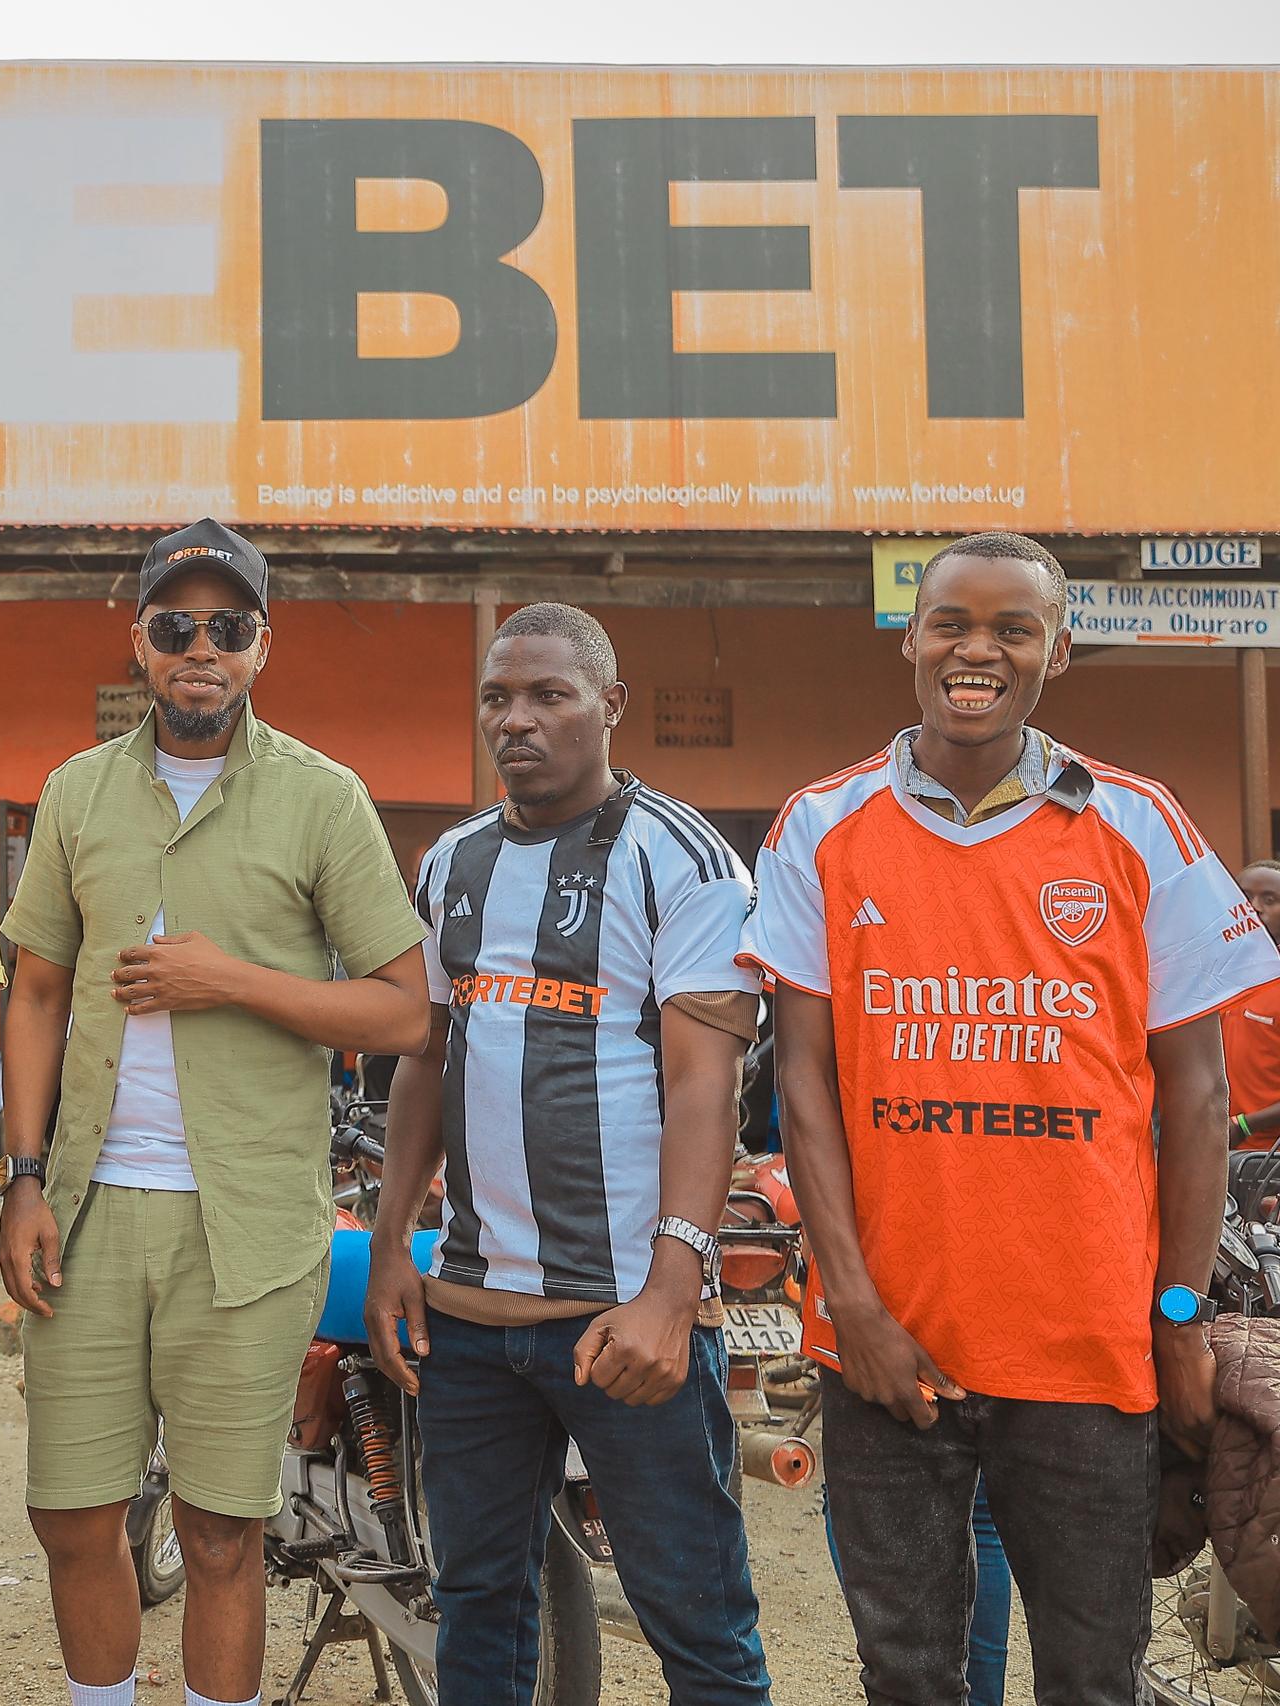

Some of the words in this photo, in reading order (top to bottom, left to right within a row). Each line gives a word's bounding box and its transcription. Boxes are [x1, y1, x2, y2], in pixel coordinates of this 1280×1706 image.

[257, 484, 334, 508] Betting
[338, 484, 356, 504] is
[361, 484, 457, 504] addictive
[462, 484, 501, 504] and
[508, 488, 546, 504] can
[552, 484, 580, 504] be
[585, 483, 742, 508] psychologically
[852, 482, 1026, 508] www.fortebet.ug
[167, 547, 233, 564] FORTEBET
[1148, 540, 1259, 568] LODGE
[1107, 585, 1143, 605] FOR
[1068, 610, 1152, 633] Kaguza
[1169, 612, 1269, 635] Oburaro
[1051, 885, 1095, 898] Arsenal
[862, 966, 1098, 1019] Emirates
[892, 1021, 941, 1061] FLY
[950, 1022, 1062, 1064] BETTER
[872, 1096, 1101, 1142] FORTEBET
[726, 1307, 783, 1327] UEV
[724, 1329, 795, 1351] 111P
